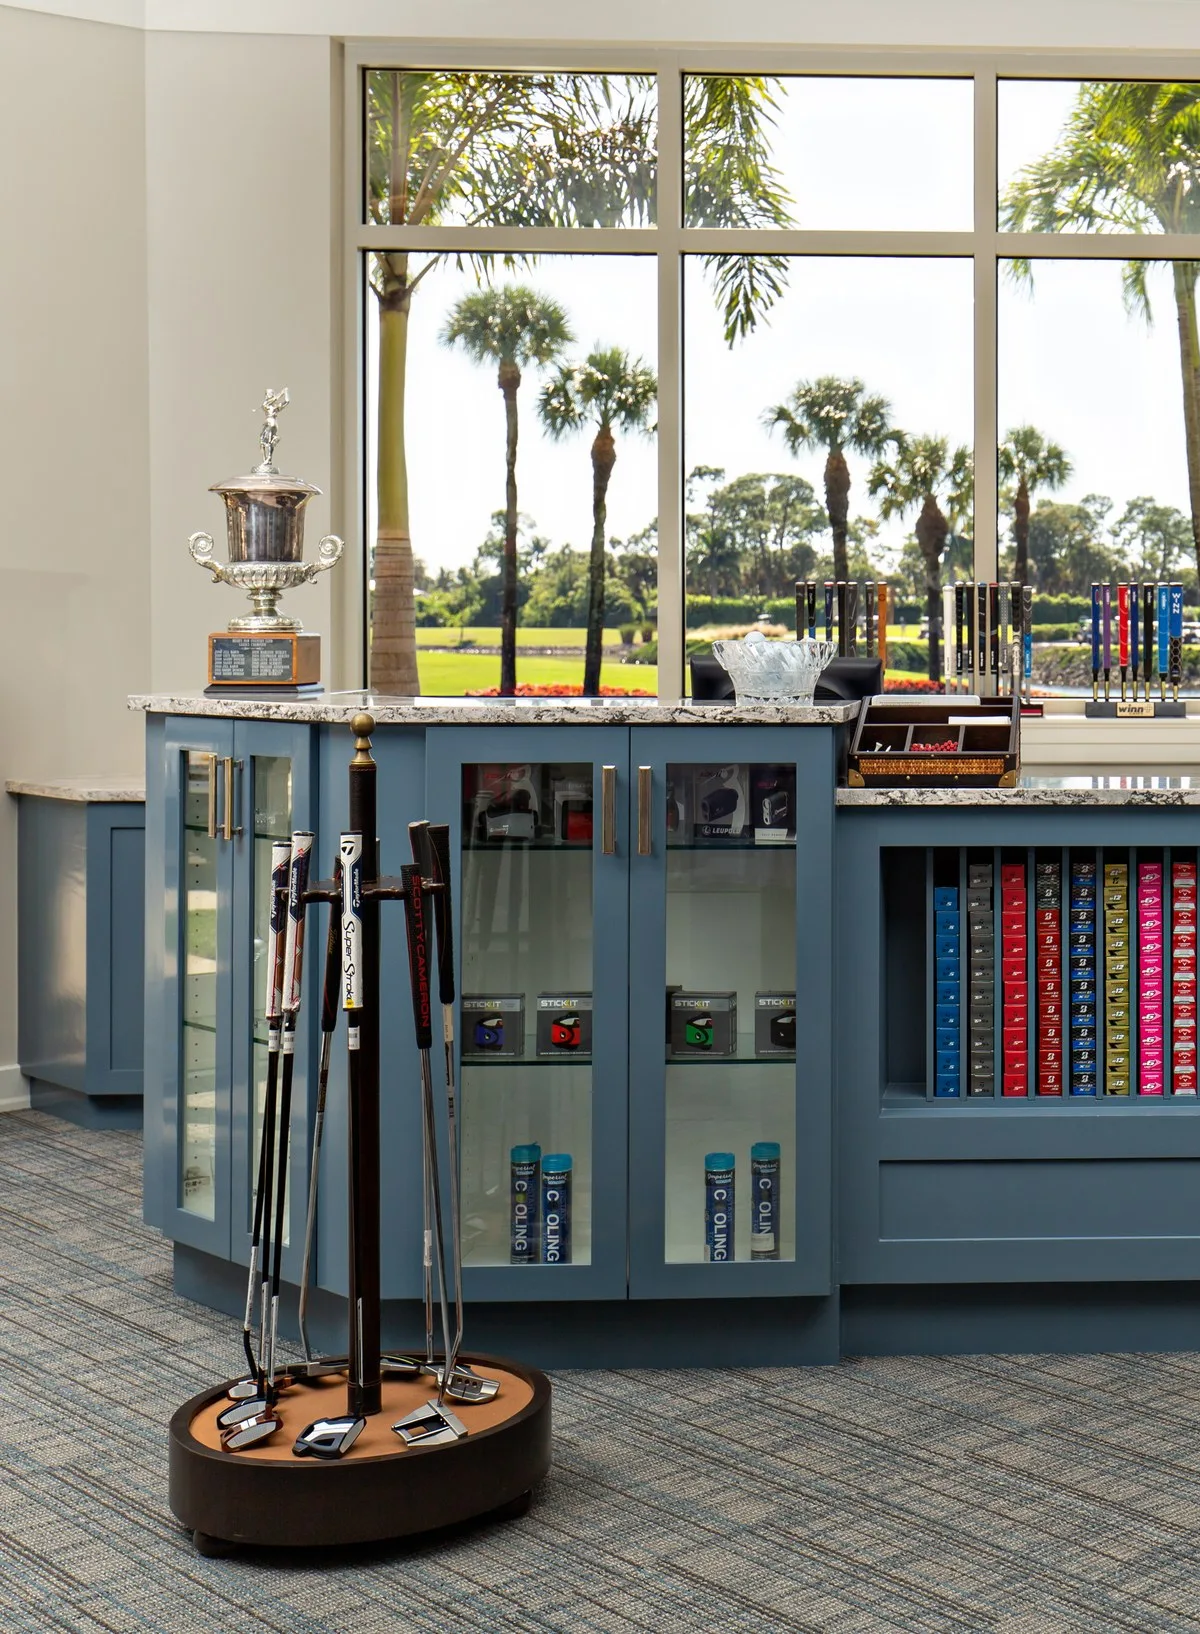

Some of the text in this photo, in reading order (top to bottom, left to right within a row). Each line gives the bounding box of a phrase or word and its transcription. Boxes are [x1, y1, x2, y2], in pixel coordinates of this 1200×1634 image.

[1172, 593, 1181, 614] WINN
[1119, 704, 1144, 713] winn
[412, 875, 430, 1027] SCOTTY CAMERON
[344, 961, 356, 1000] Strok
